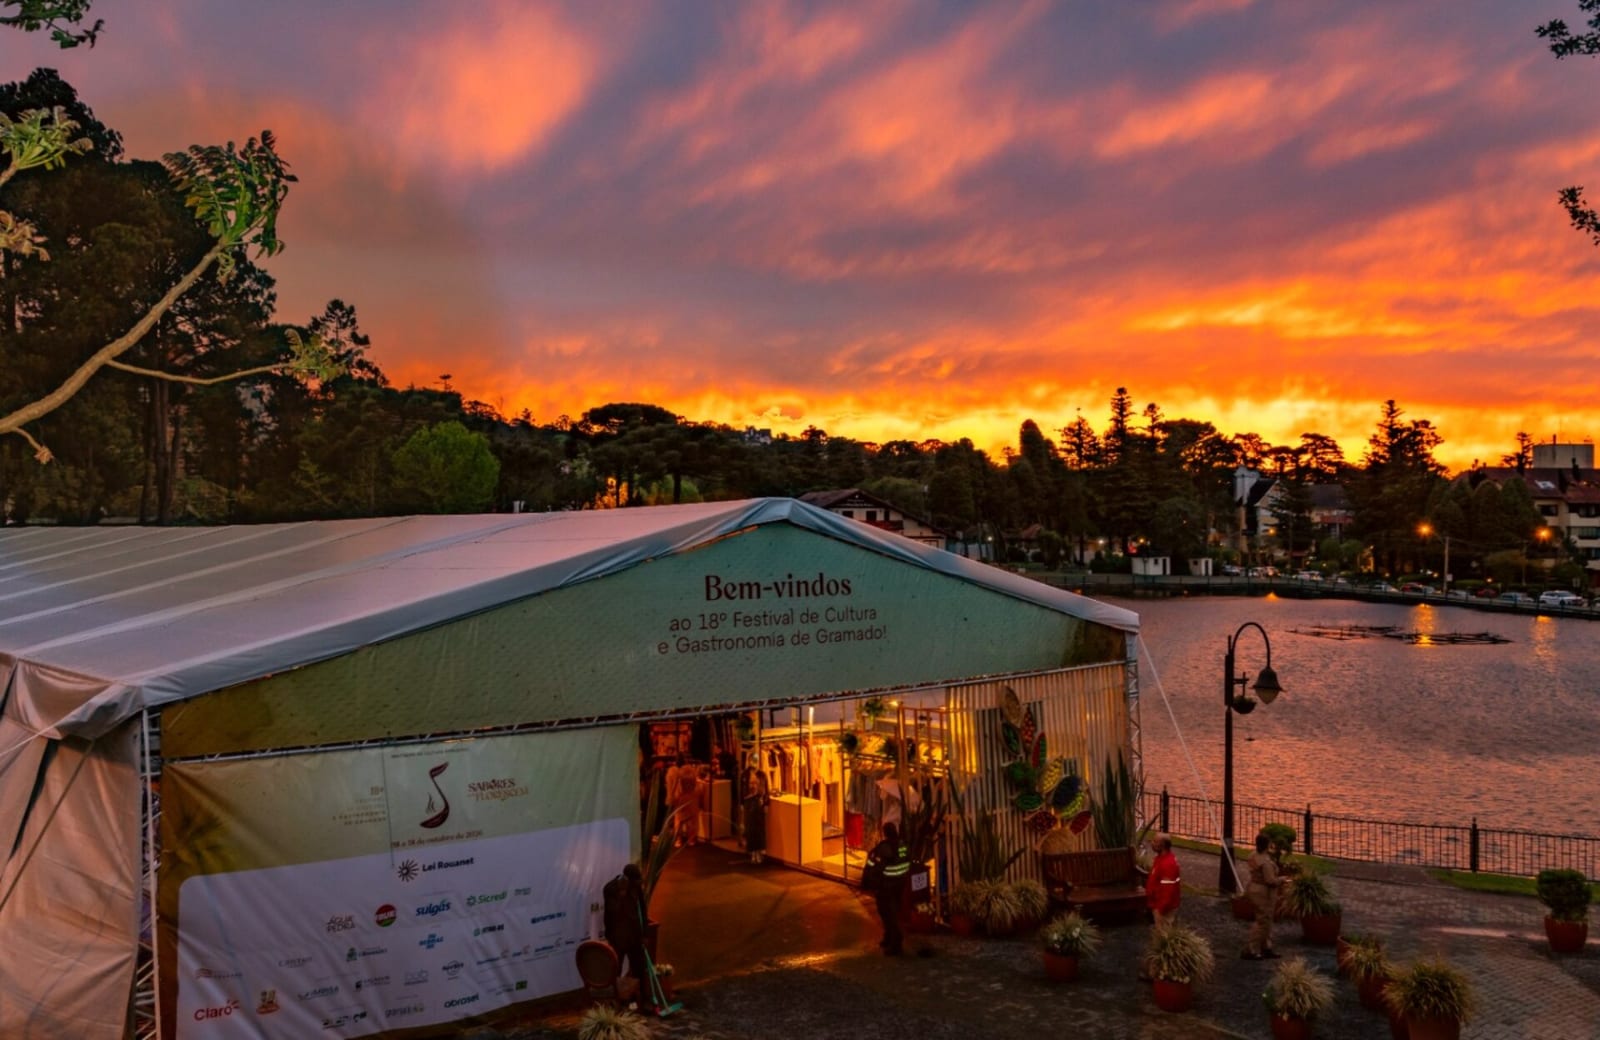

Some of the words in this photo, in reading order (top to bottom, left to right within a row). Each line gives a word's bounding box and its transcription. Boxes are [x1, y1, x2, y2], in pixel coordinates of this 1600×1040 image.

[705, 573, 852, 601] Bem-vindos
[669, 618, 691, 631] ao
[699, 613, 727, 630] 18º
[733, 609, 794, 628] Festival
[800, 609, 819, 624] de
[825, 606, 877, 622] Cultura
[657, 641, 668, 654] e
[676, 632, 785, 654] Gastronomia
[791, 630, 810, 646] de
[816, 625, 887, 644] Gramado!
[422, 861, 436, 872] Lei
[438, 857, 474, 869] Rouanet
[416, 898, 451, 916] sulgás
[194, 1005, 233, 1021] Claro
